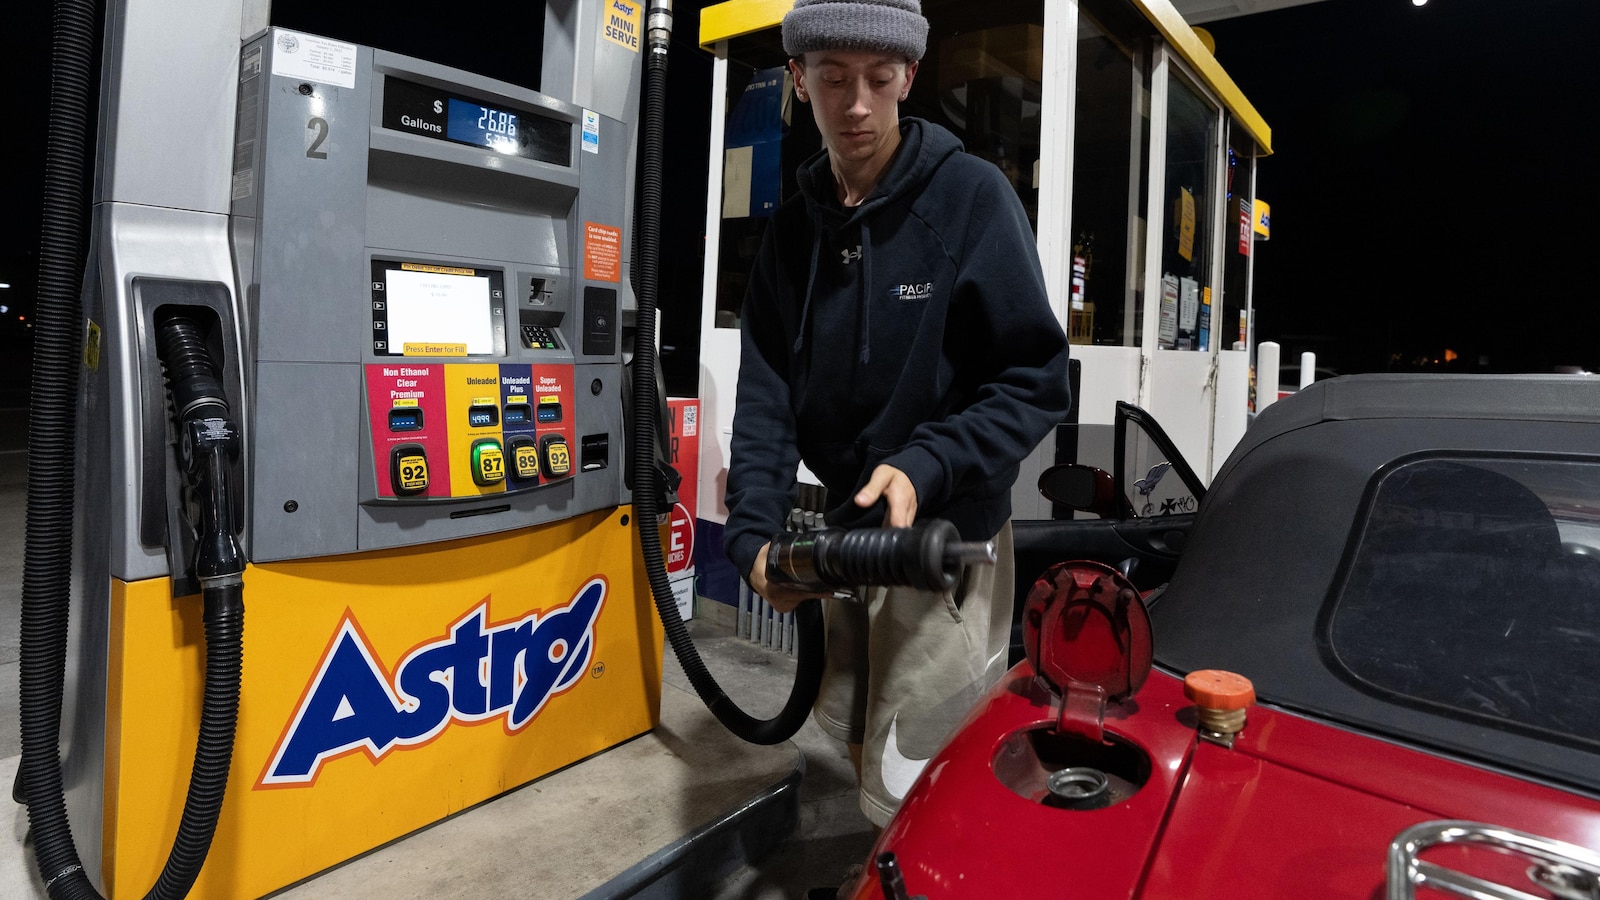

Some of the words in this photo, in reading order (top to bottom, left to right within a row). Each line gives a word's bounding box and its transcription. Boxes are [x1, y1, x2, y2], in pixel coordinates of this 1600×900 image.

[611, 15, 633, 34] MINI
[606, 26, 637, 47] SERVE
[434, 100, 443, 114] $
[401, 115, 442, 133] Gallons
[306, 117, 328, 159] 2
[384, 368, 398, 376] Non
[400, 368, 429, 376] Ethanol
[397, 379, 417, 387] Clear
[391, 390, 424, 398] Premium
[483, 458, 502, 471] 87
[519, 455, 536, 468] 89
[551, 452, 568, 465] 92
[402, 466, 425, 480] 92
[668, 550, 684, 564] UCHES
[255, 577, 606, 788] Astro
